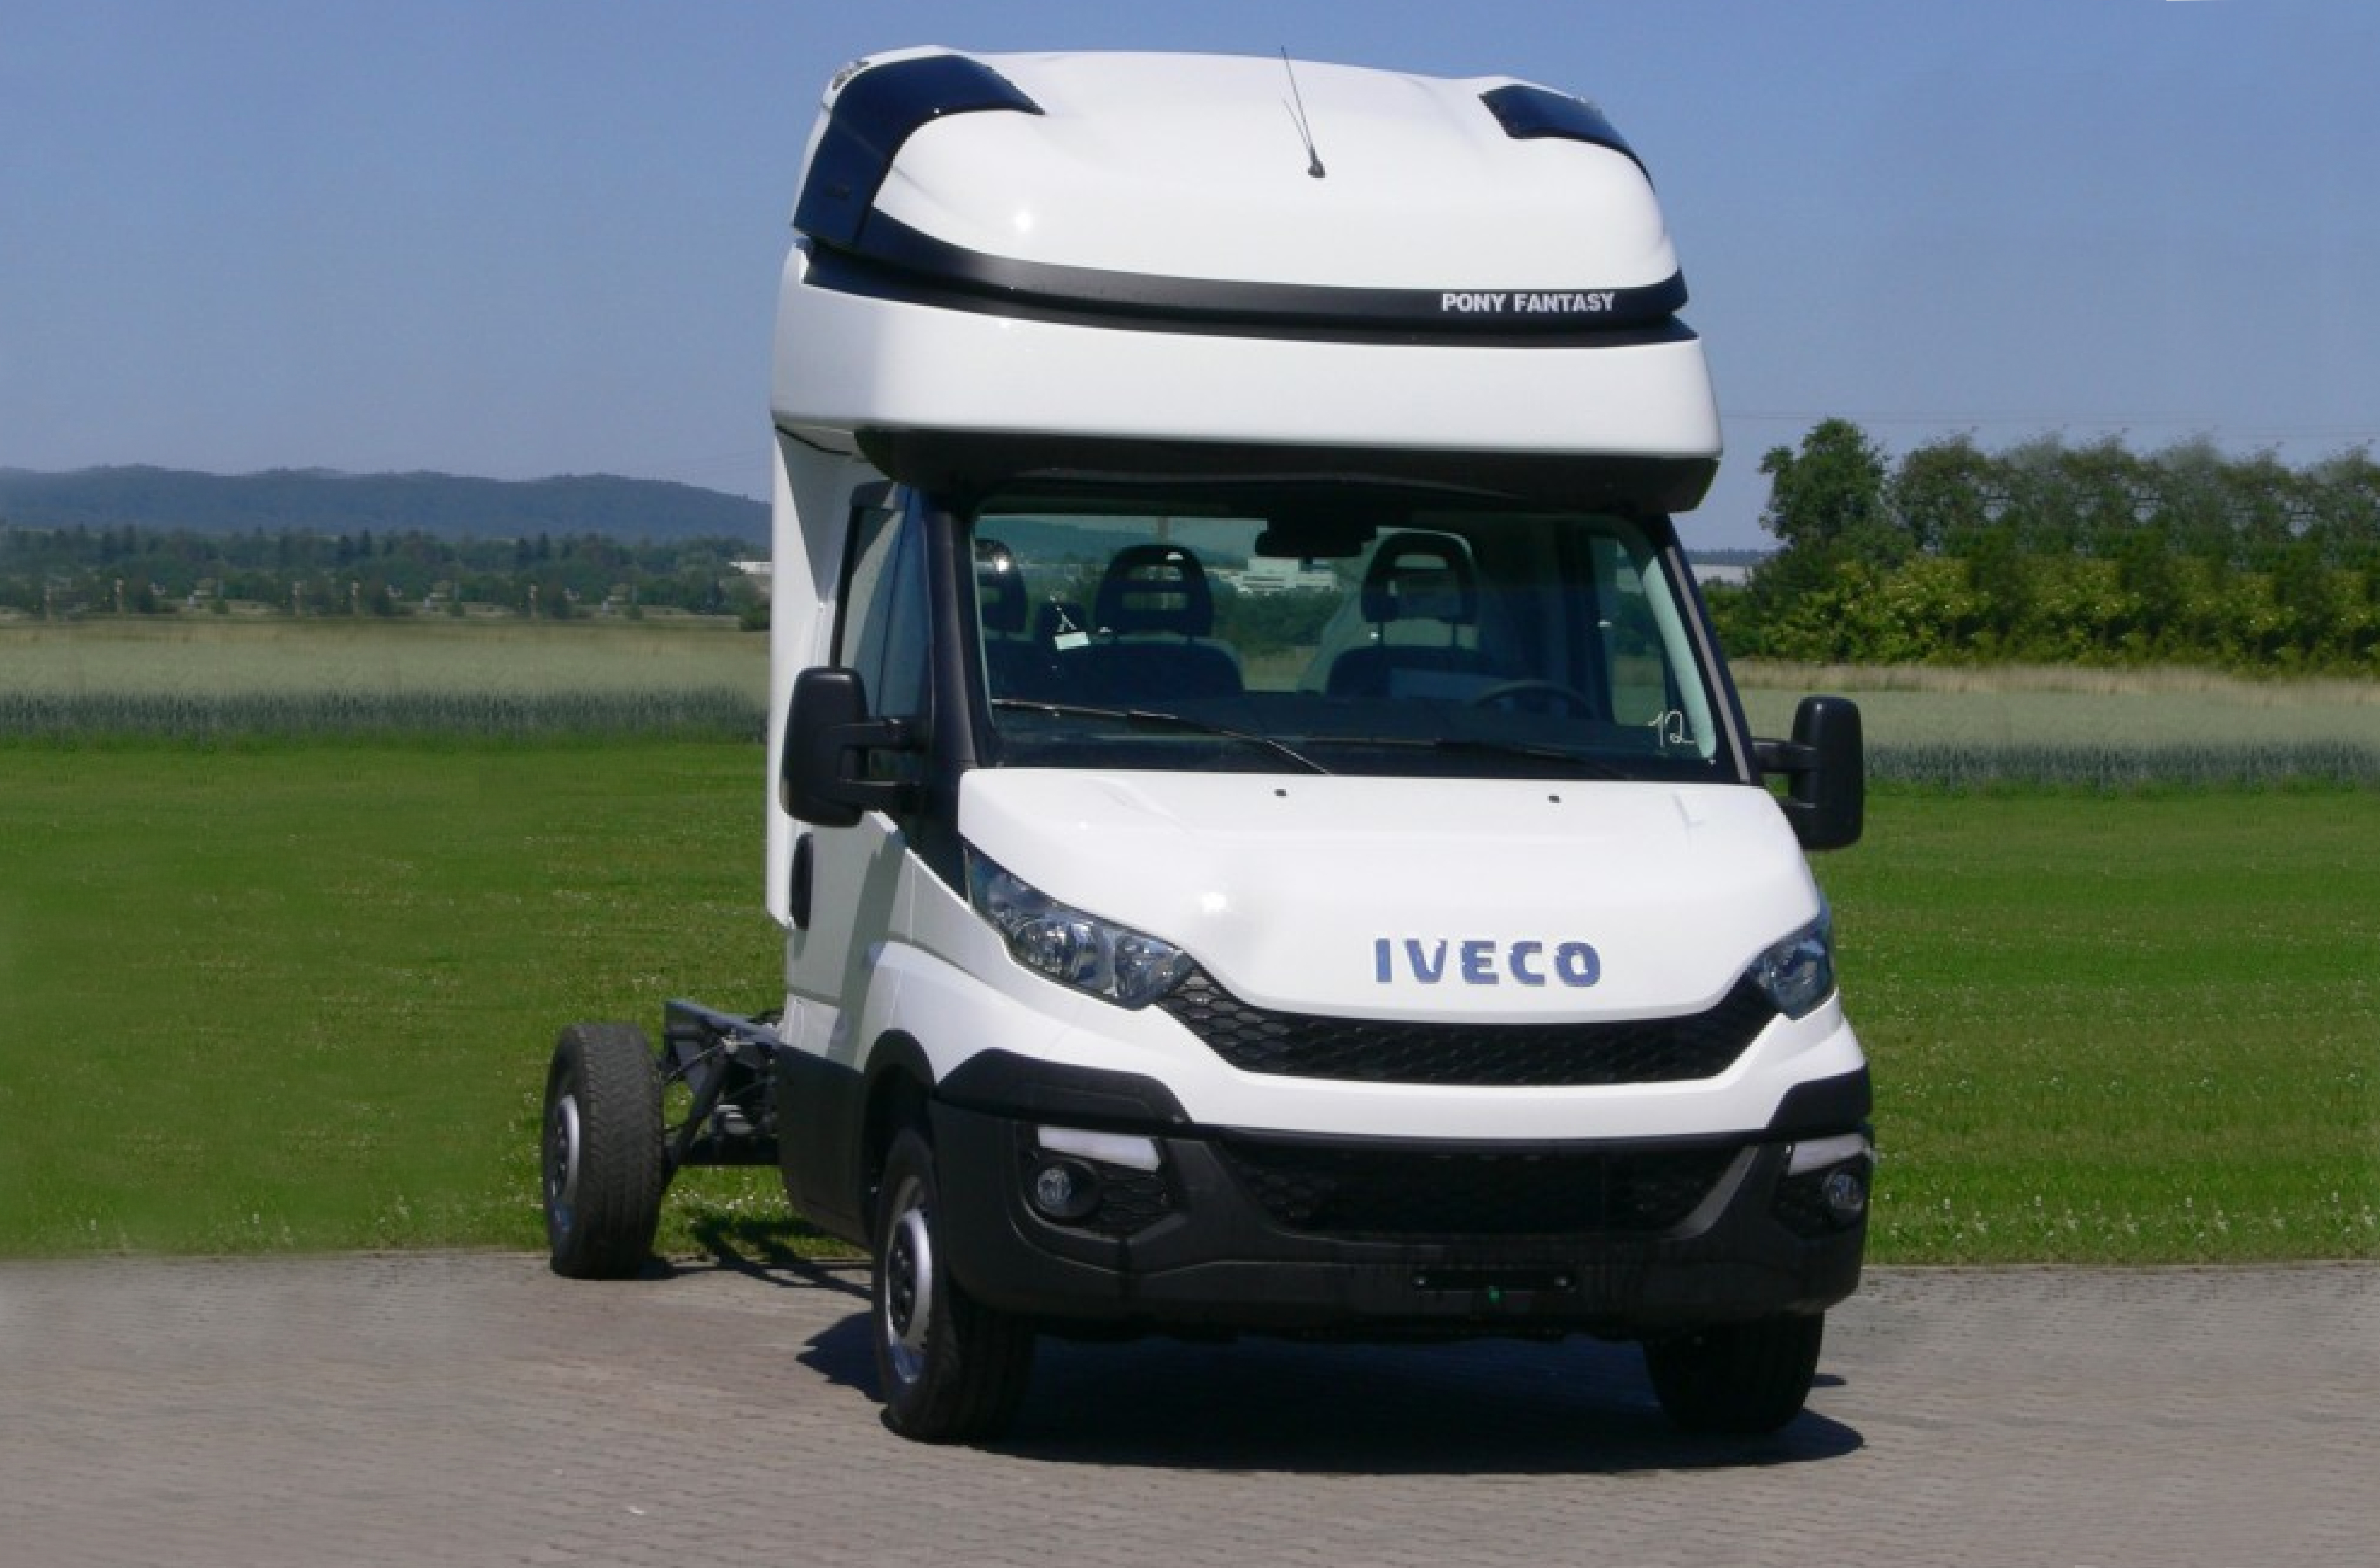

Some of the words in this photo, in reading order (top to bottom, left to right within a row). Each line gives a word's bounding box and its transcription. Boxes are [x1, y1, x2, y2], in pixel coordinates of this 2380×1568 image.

[1441, 293, 1506, 313] PONY
[1513, 291, 1615, 314] FANTASY
[1648, 709, 1695, 748] 12
[1374, 938, 1601, 987] IVECO
